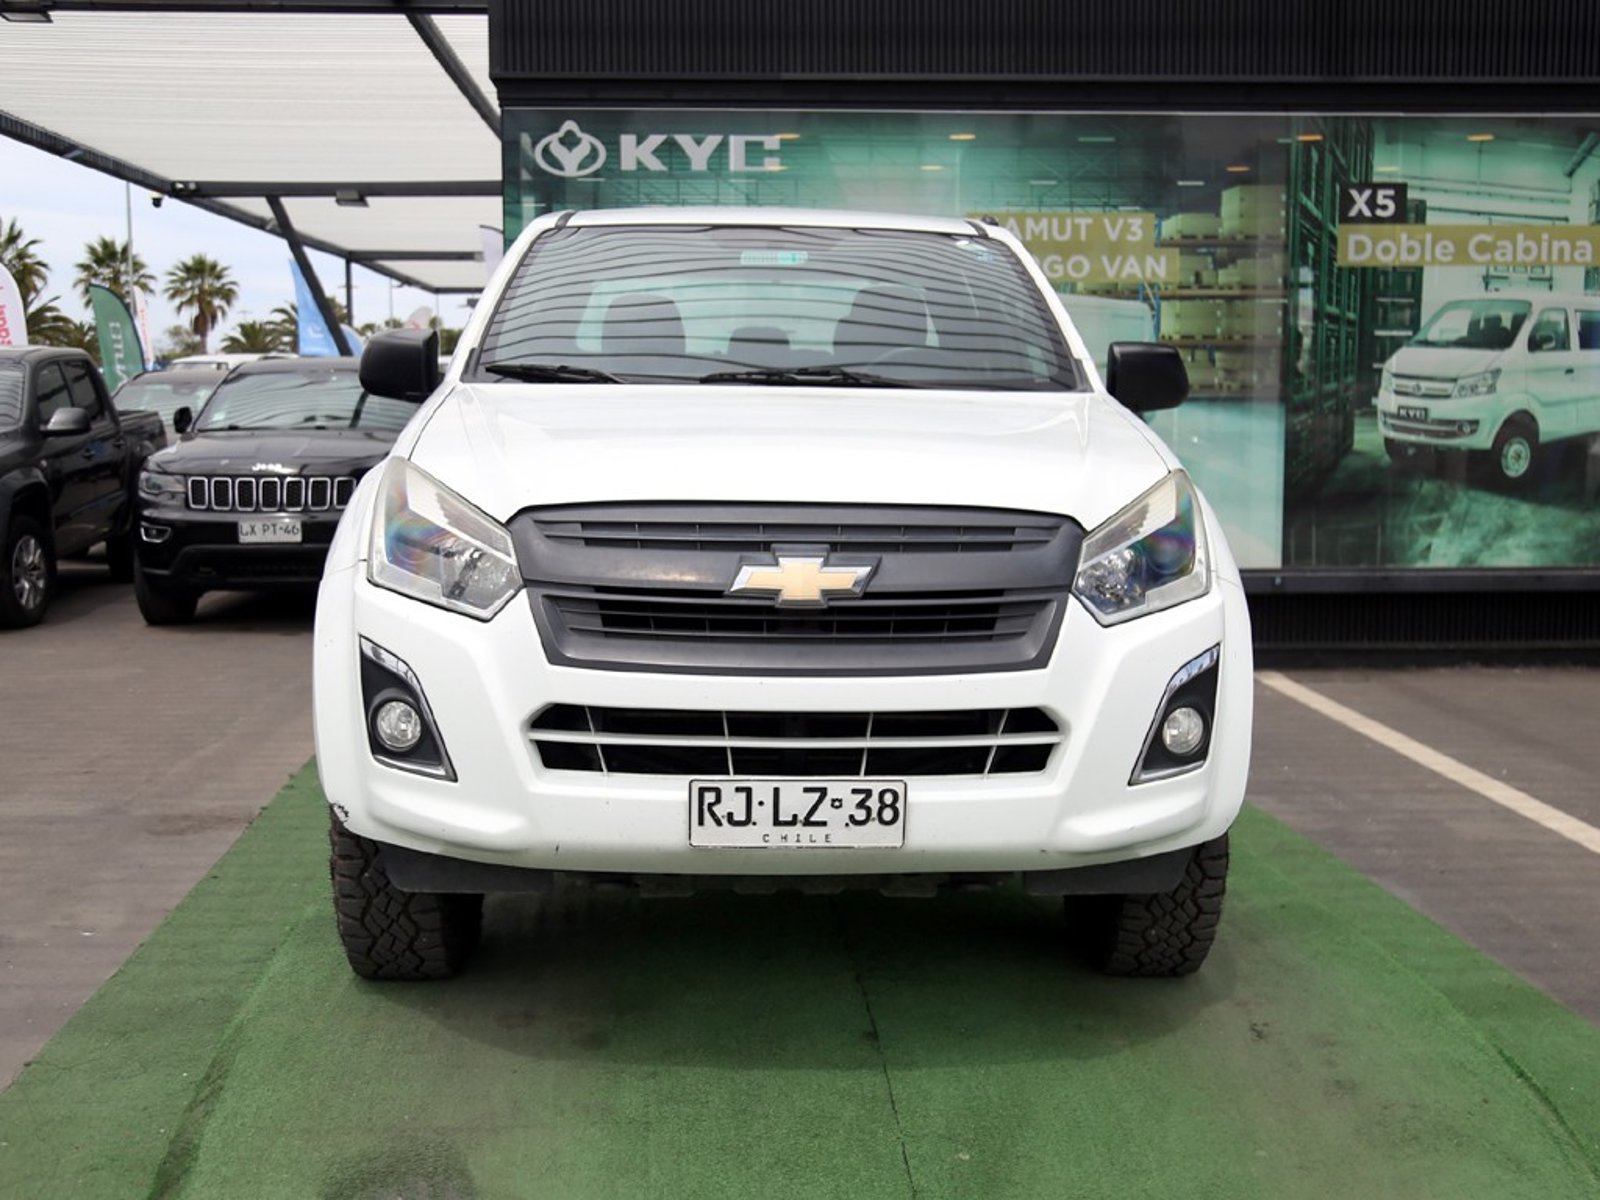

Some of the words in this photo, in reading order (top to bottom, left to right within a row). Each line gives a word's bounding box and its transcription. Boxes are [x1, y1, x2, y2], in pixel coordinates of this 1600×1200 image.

[619, 133, 781, 172] KYC
[1348, 188, 1397, 218] X5
[1004, 217, 1093, 242] AMUT
[1103, 217, 1144, 242] V3
[1347, 232, 1456, 263] Doble
[1467, 232, 1594, 263] Cabina
[1033, 254, 1092, 279] GO
[1101, 255, 1167, 279] VAN
[762, 833, 832, 844] CHILE
